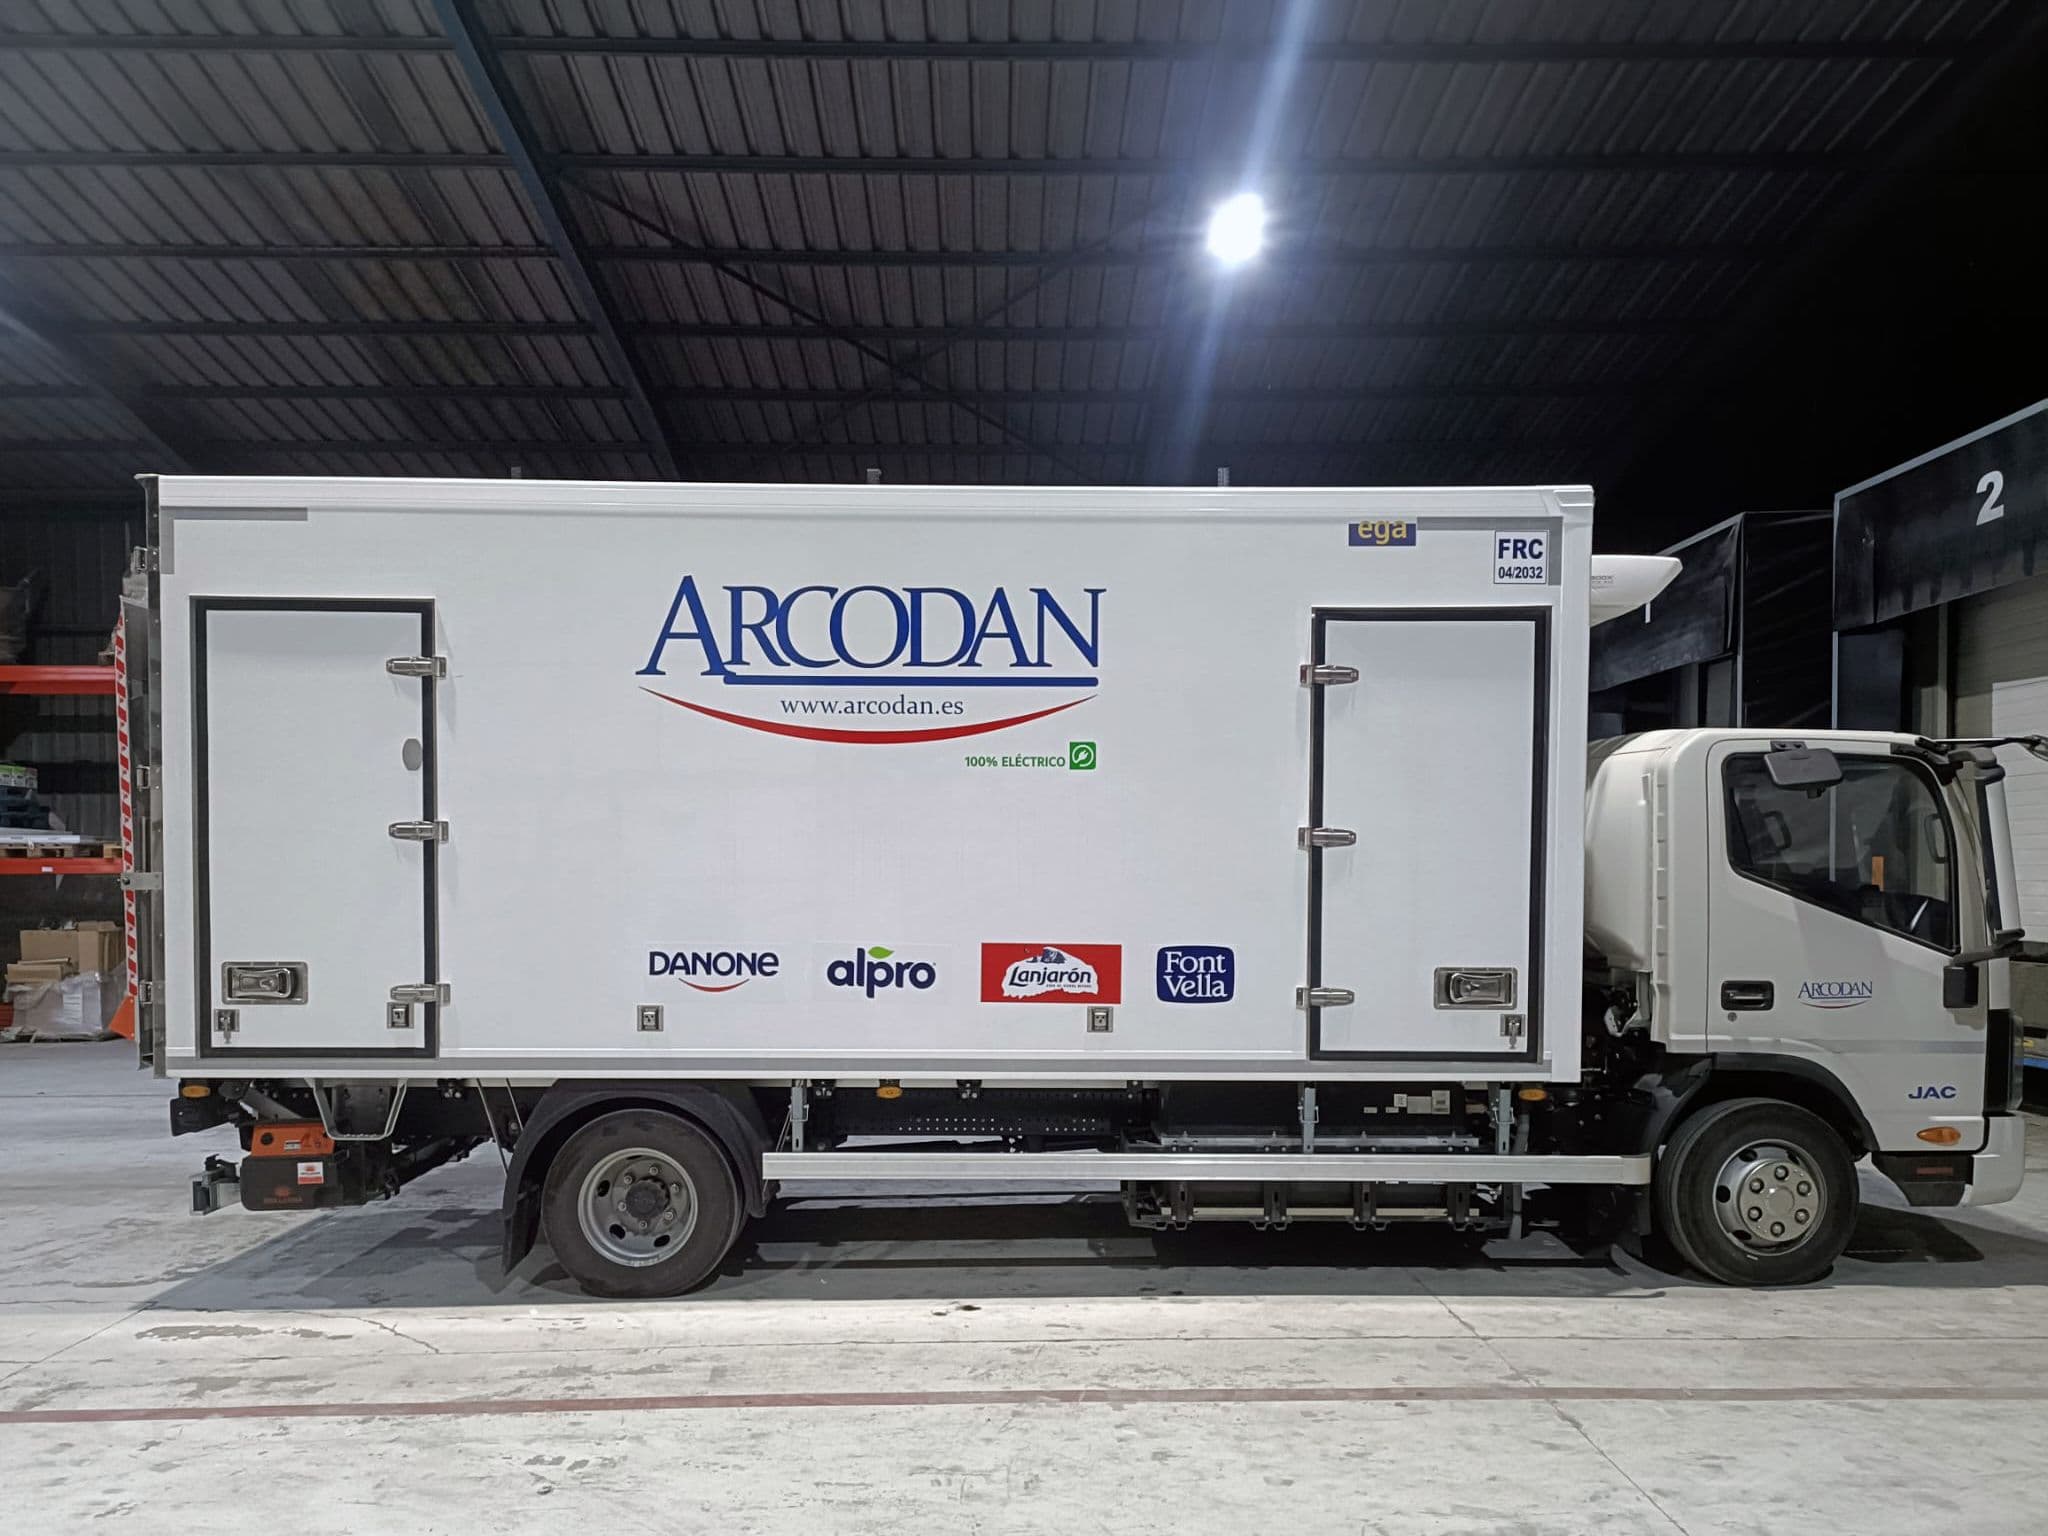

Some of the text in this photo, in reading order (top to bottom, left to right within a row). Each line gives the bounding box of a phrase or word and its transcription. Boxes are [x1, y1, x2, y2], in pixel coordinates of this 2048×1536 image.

[1975, 470, 2004, 526] 2
[1358, 520, 1407, 545] ega
[1498, 539, 1543, 559] FRC
[1498, 566, 1543, 579] 04/2032
[635, 575, 1107, 675] ARCODAN
[780, 694, 964, 716] www.arcodan.es
[965, 753, 1066, 767] 100% ELÉCTRICO
[827, 947, 936, 999] alpro
[1165, 951, 1226, 974] Font
[1008, 966, 1091, 987] Lanjarón
[1164, 975, 1227, 998] Vella
[1798, 981, 1873, 999] ARCODAN
[1908, 1086, 1957, 1099] JAC
